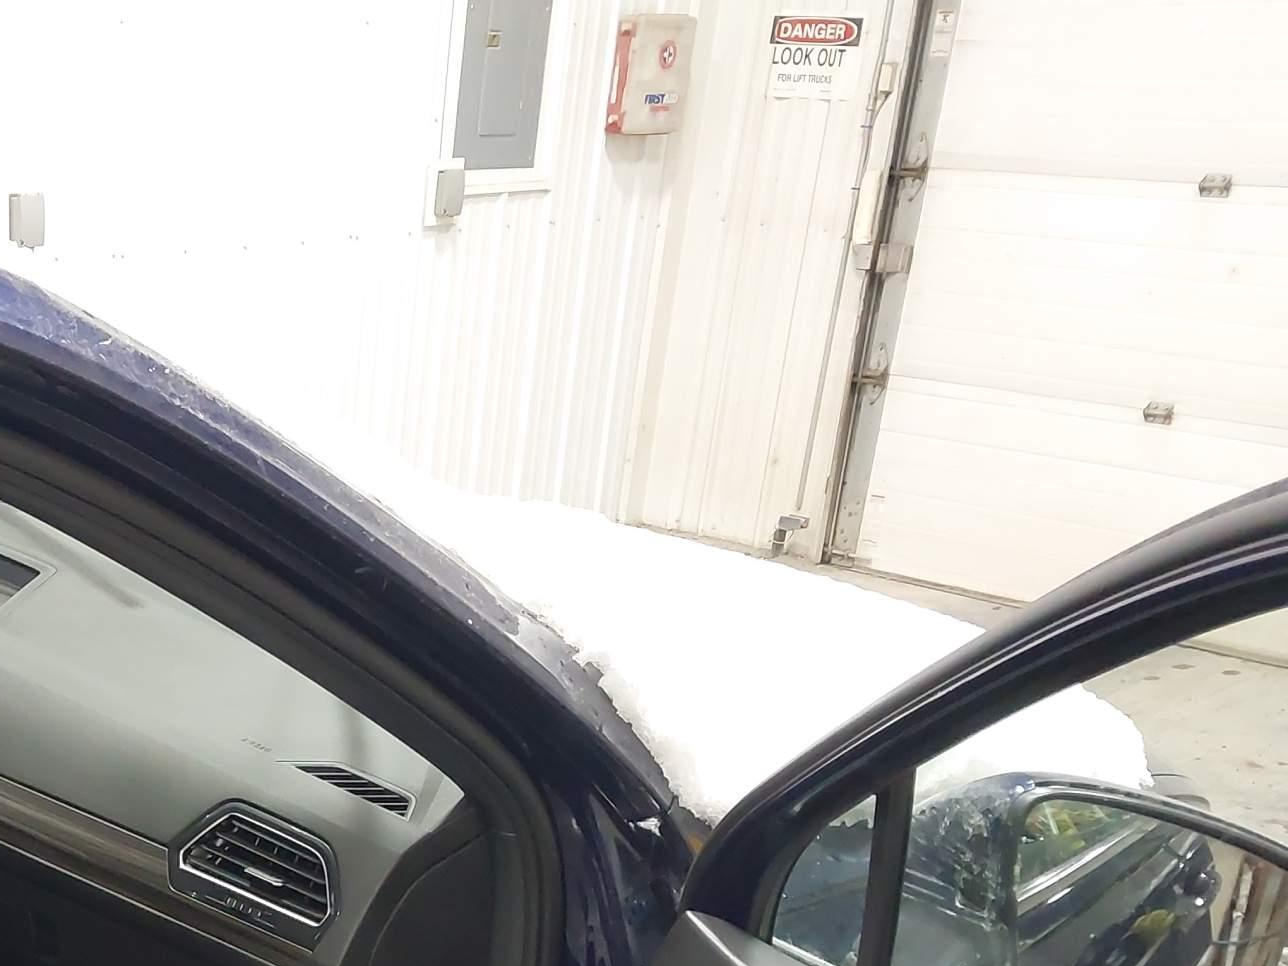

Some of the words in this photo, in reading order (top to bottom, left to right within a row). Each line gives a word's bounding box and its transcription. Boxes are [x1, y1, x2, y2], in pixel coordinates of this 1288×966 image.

[779, 22, 846, 40] DANGER
[772, 46, 814, 66] LOOK
[817, 48, 847, 67] OUT
[777, 73, 792, 82] FOR
[793, 74, 807, 83] LIFT
[808, 74, 832, 84] TRUCKS
